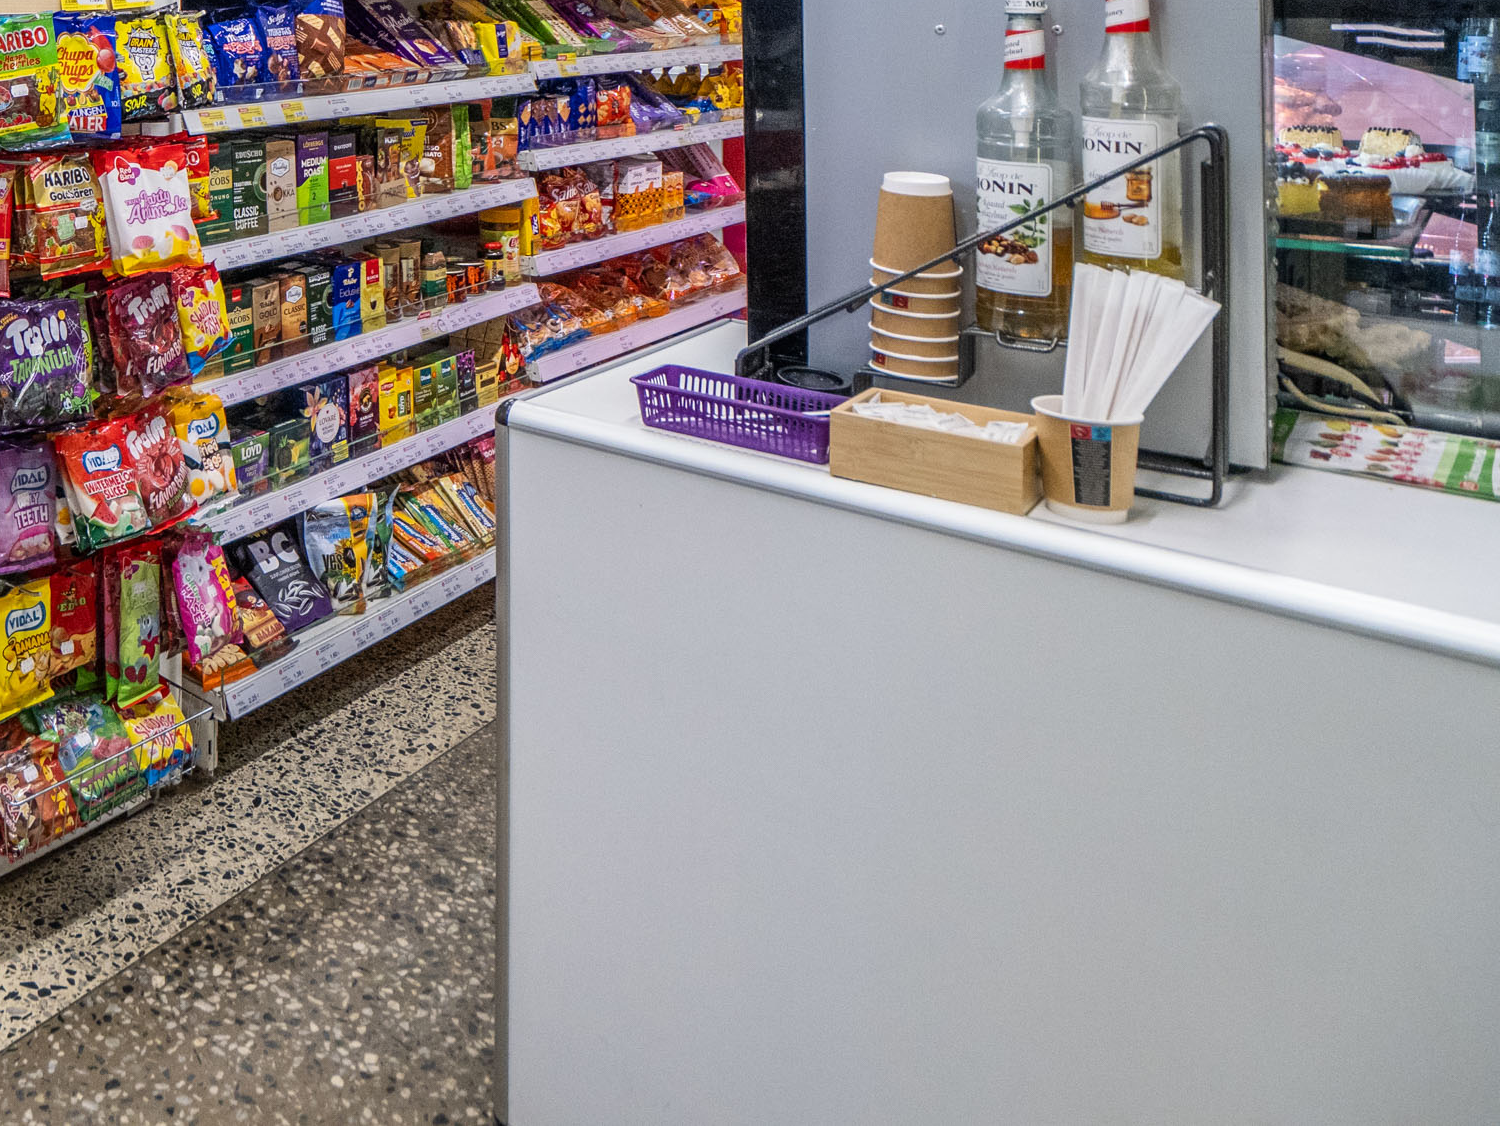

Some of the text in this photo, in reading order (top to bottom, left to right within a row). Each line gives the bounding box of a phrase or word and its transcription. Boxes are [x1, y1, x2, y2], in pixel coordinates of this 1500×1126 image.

[1106, 8, 1124, 18] oney
[131, 38, 154, 48] BRAIN
[125, 96, 147, 113] SOUR
[67, 116, 106, 132] ALER
[235, 149, 263, 159] EDUSCHO
[301, 157, 327, 169] MEDIUM
[44, 166, 90, 187] HARIBO
[303, 167, 324, 178] ROAST
[210, 175, 230, 187] COBS
[234, 206, 259, 219] CLASSIC
[259, 309, 278, 320] GOLD
[284, 304, 306, 316] CLASSIC
[6, 309, 69, 357] Trolli
[9, 344, 76, 385] TARANTULA
[241, 443, 262, 461] LOYD
[103, 484, 128, 500] SLICES
[14, 505, 50, 529] TEETH
[9, 610, 40, 629] VIDAL
